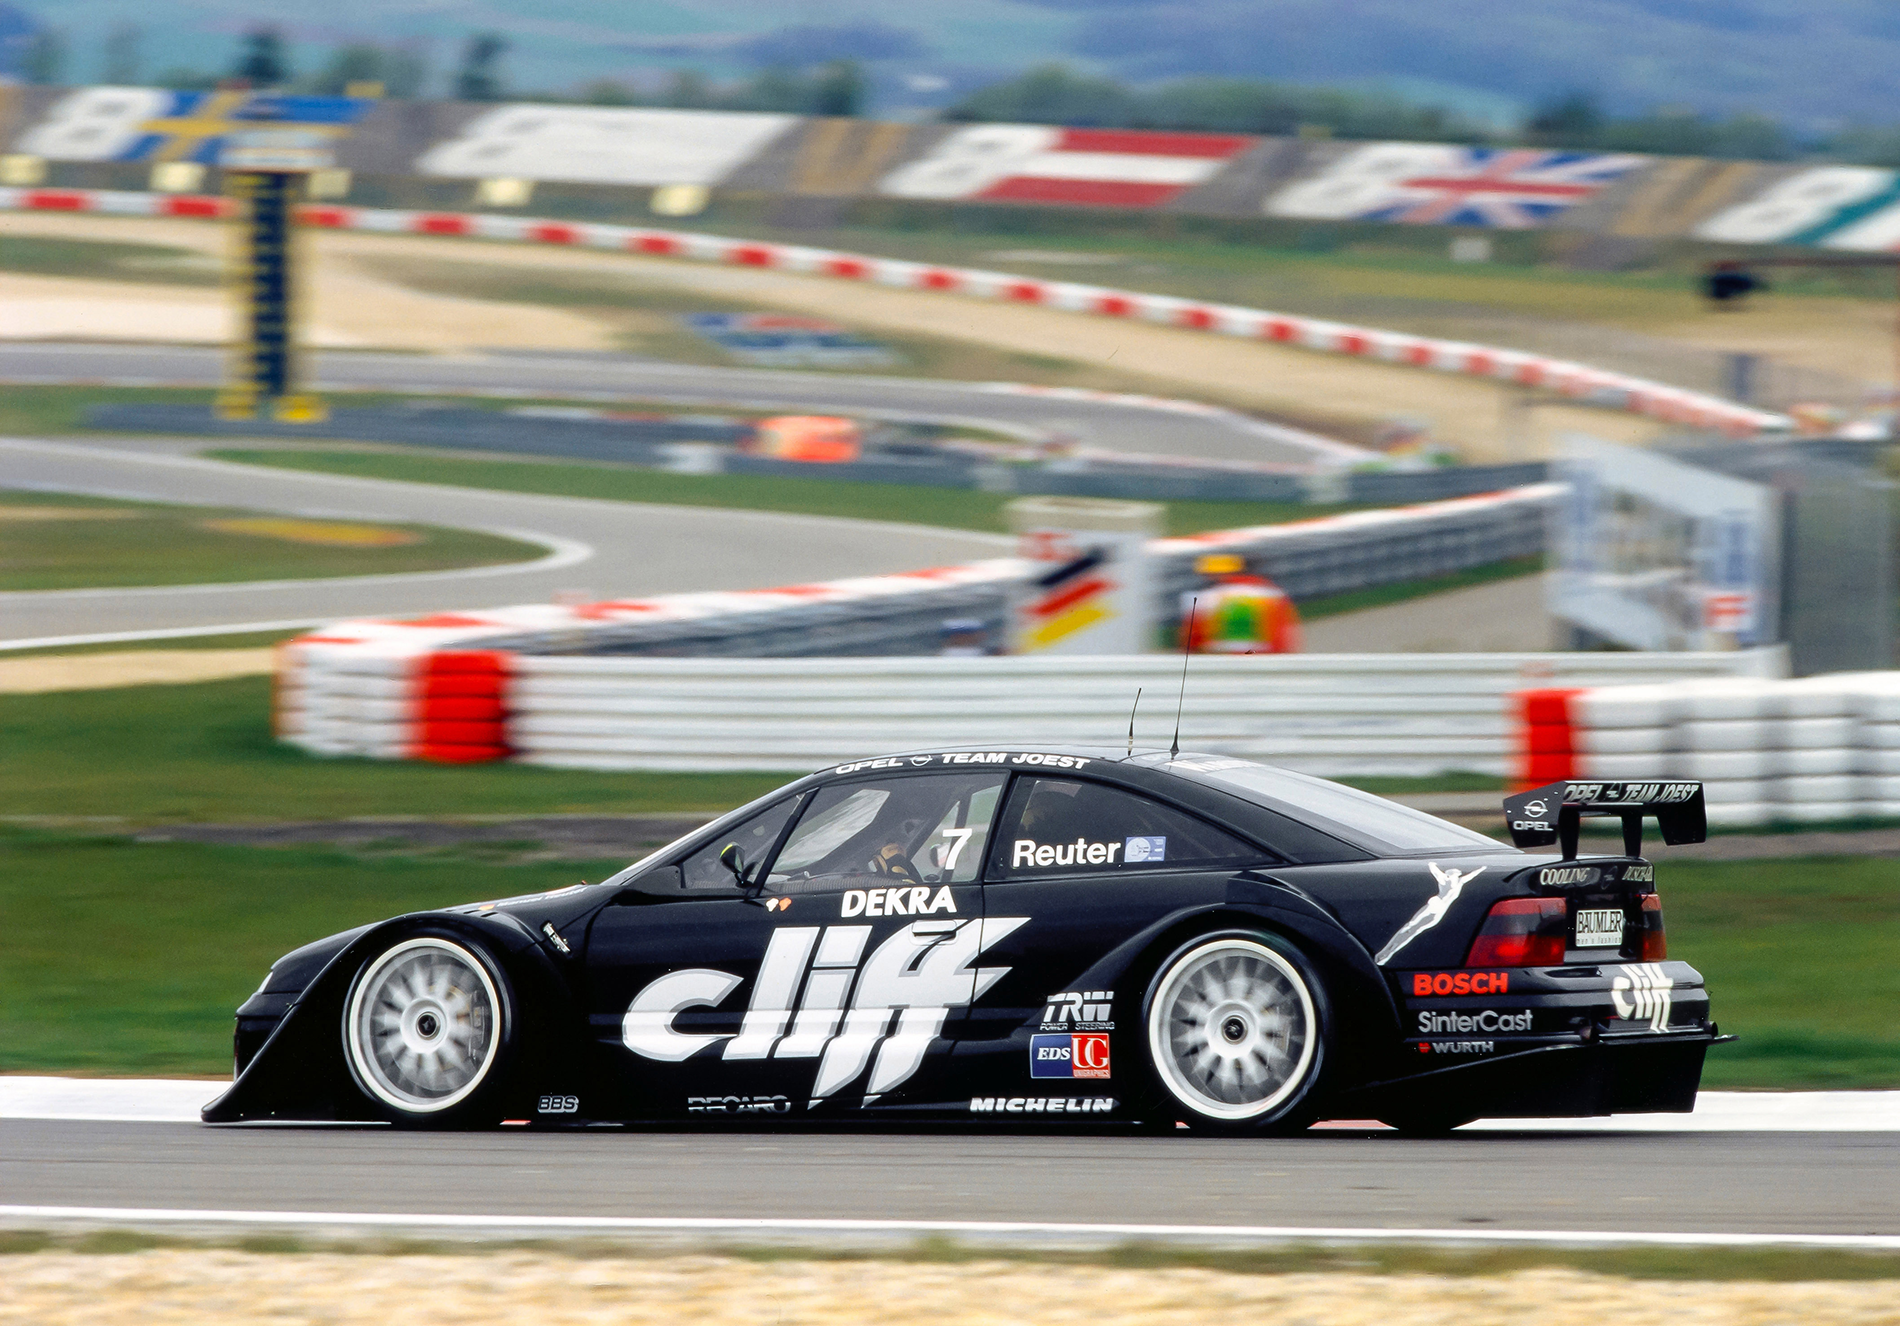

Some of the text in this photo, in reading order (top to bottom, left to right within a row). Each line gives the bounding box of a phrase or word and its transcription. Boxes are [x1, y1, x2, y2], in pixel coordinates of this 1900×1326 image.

[835, 752, 1090, 774] OPEL TEAM JOEST
[1563, 783, 1700, 803] OPEL TEAM JOEST
[1513, 820, 1554, 831] OPEL
[942, 828, 972, 870] 7
[1012, 838, 1121, 867] Reuter
[1540, 867, 1590, 885] COOLING
[841, 885, 957, 918] DEKRA
[1413, 972, 1508, 996] BOSCH
[1043, 991, 1114, 1022] TRW
[1610, 963, 1673, 1034] cliff
[622, 918, 1031, 1109] cliff
[1418, 1010, 1533, 1032] SinterCast
[1040, 1022, 1115, 1031] POWER STEERING
[1037, 1047, 1071, 1060] EDS
[1072, 1037, 1109, 1068] UG
[538, 1095, 579, 1113] BBS
[688, 1095, 791, 1113] RECARO
[970, 1097, 1114, 1112] MICHELIN
